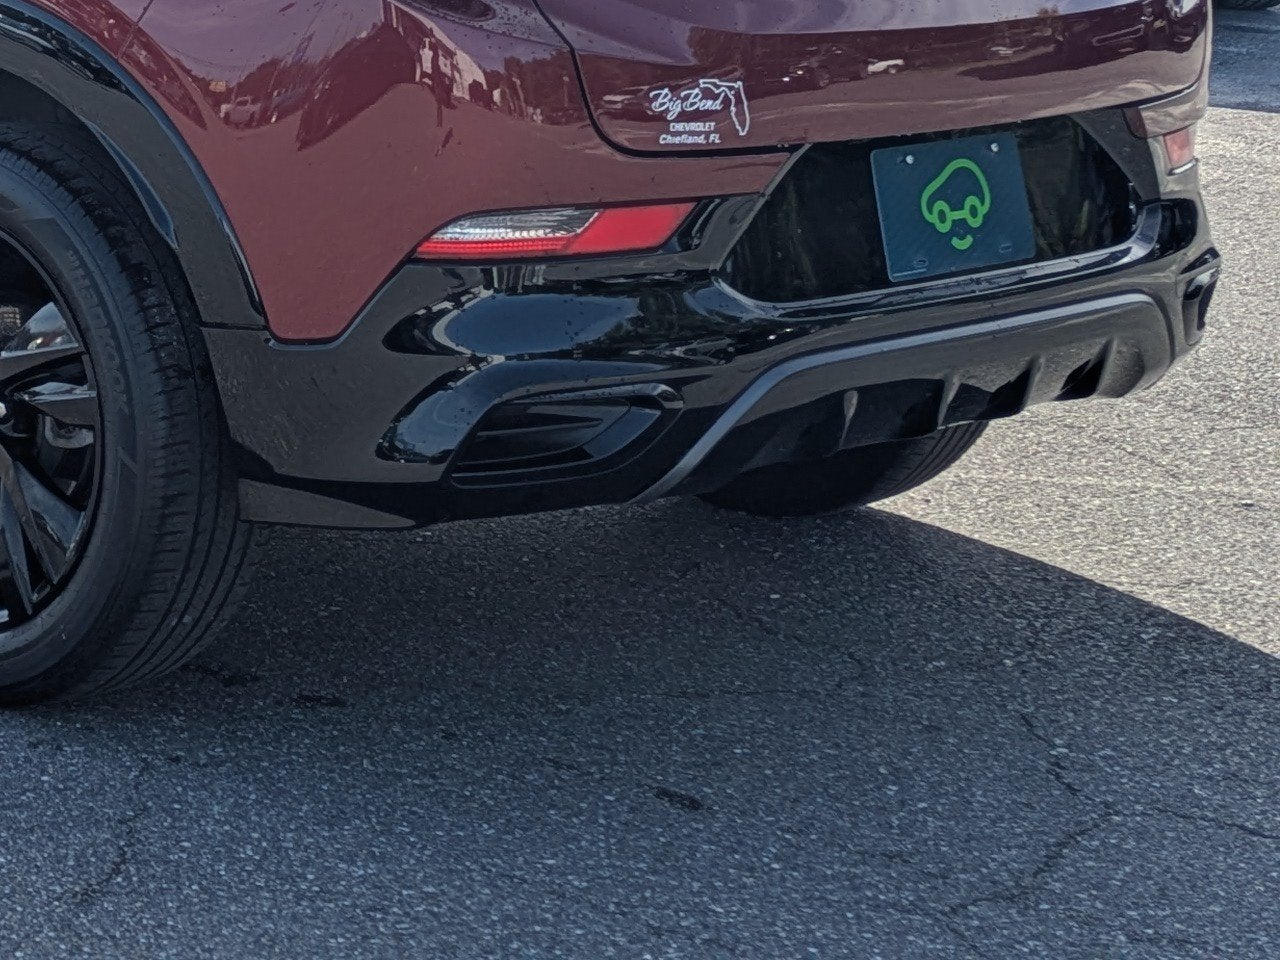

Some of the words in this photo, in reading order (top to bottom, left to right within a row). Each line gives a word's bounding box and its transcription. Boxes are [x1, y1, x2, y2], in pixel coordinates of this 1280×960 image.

[649, 87, 682, 120] Big
[680, 87, 726, 112] Bend
[669, 122, 716, 132] CHEVROLET
[708, 133, 722, 144] FL
